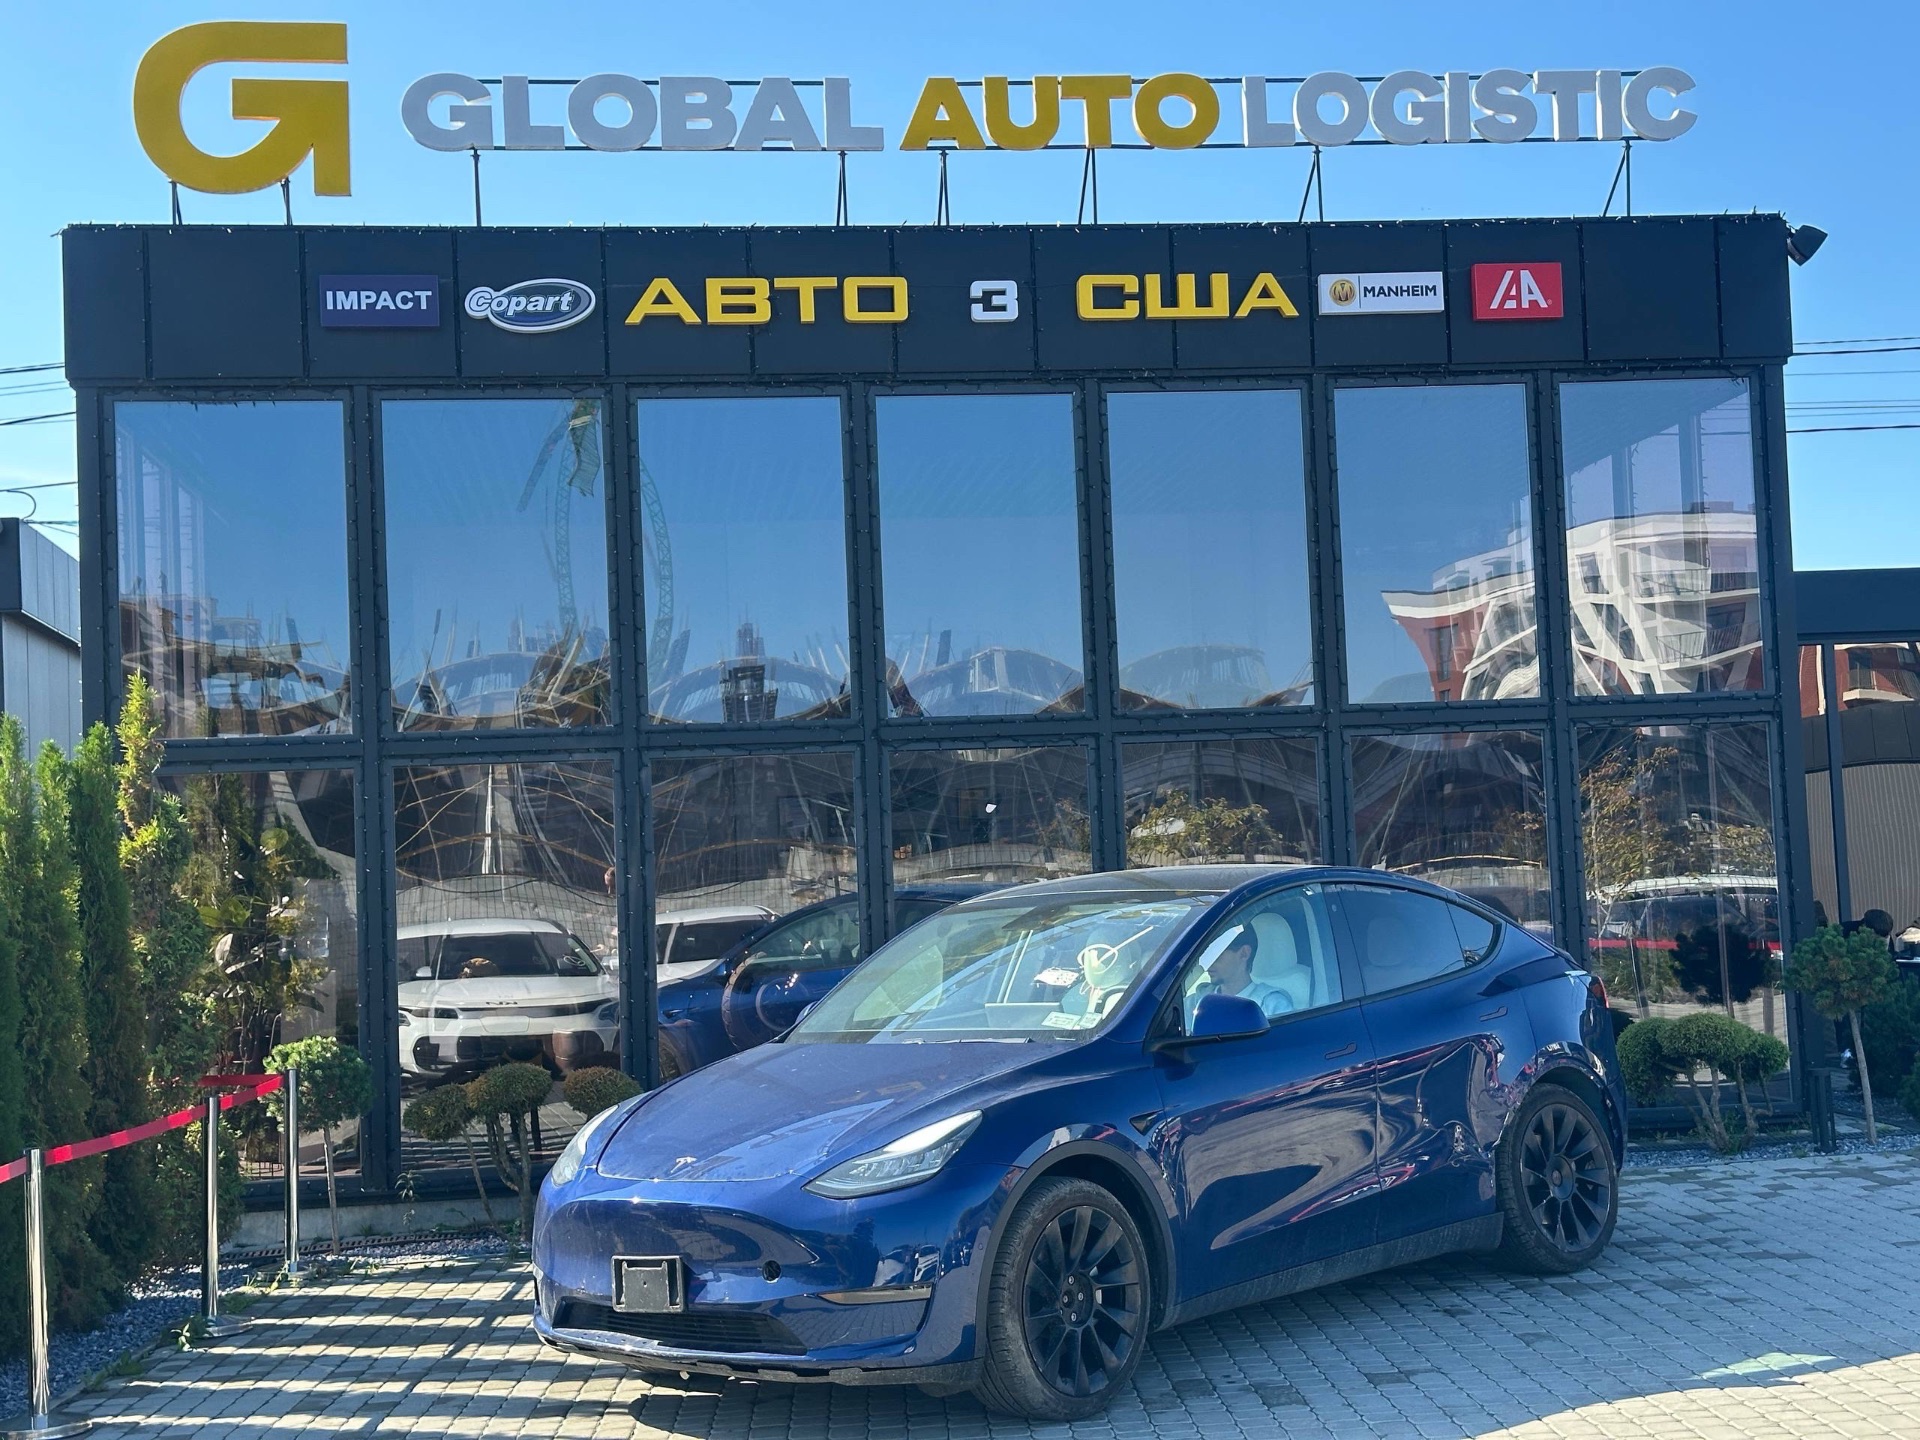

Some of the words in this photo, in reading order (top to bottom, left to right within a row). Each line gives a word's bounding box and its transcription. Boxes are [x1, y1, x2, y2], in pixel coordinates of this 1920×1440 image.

[401, 72, 885, 153] GLOBAL
[900, 73, 1221, 151] AUTO
[1243, 67, 1699, 147] LOGISTIC
[326, 290, 432, 310] IMPACT
[466, 288, 575, 317] Copart
[625, 276, 909, 325] АВТО
[1076, 272, 1300, 321] США
[1363, 284, 1437, 298] MANHEIM
